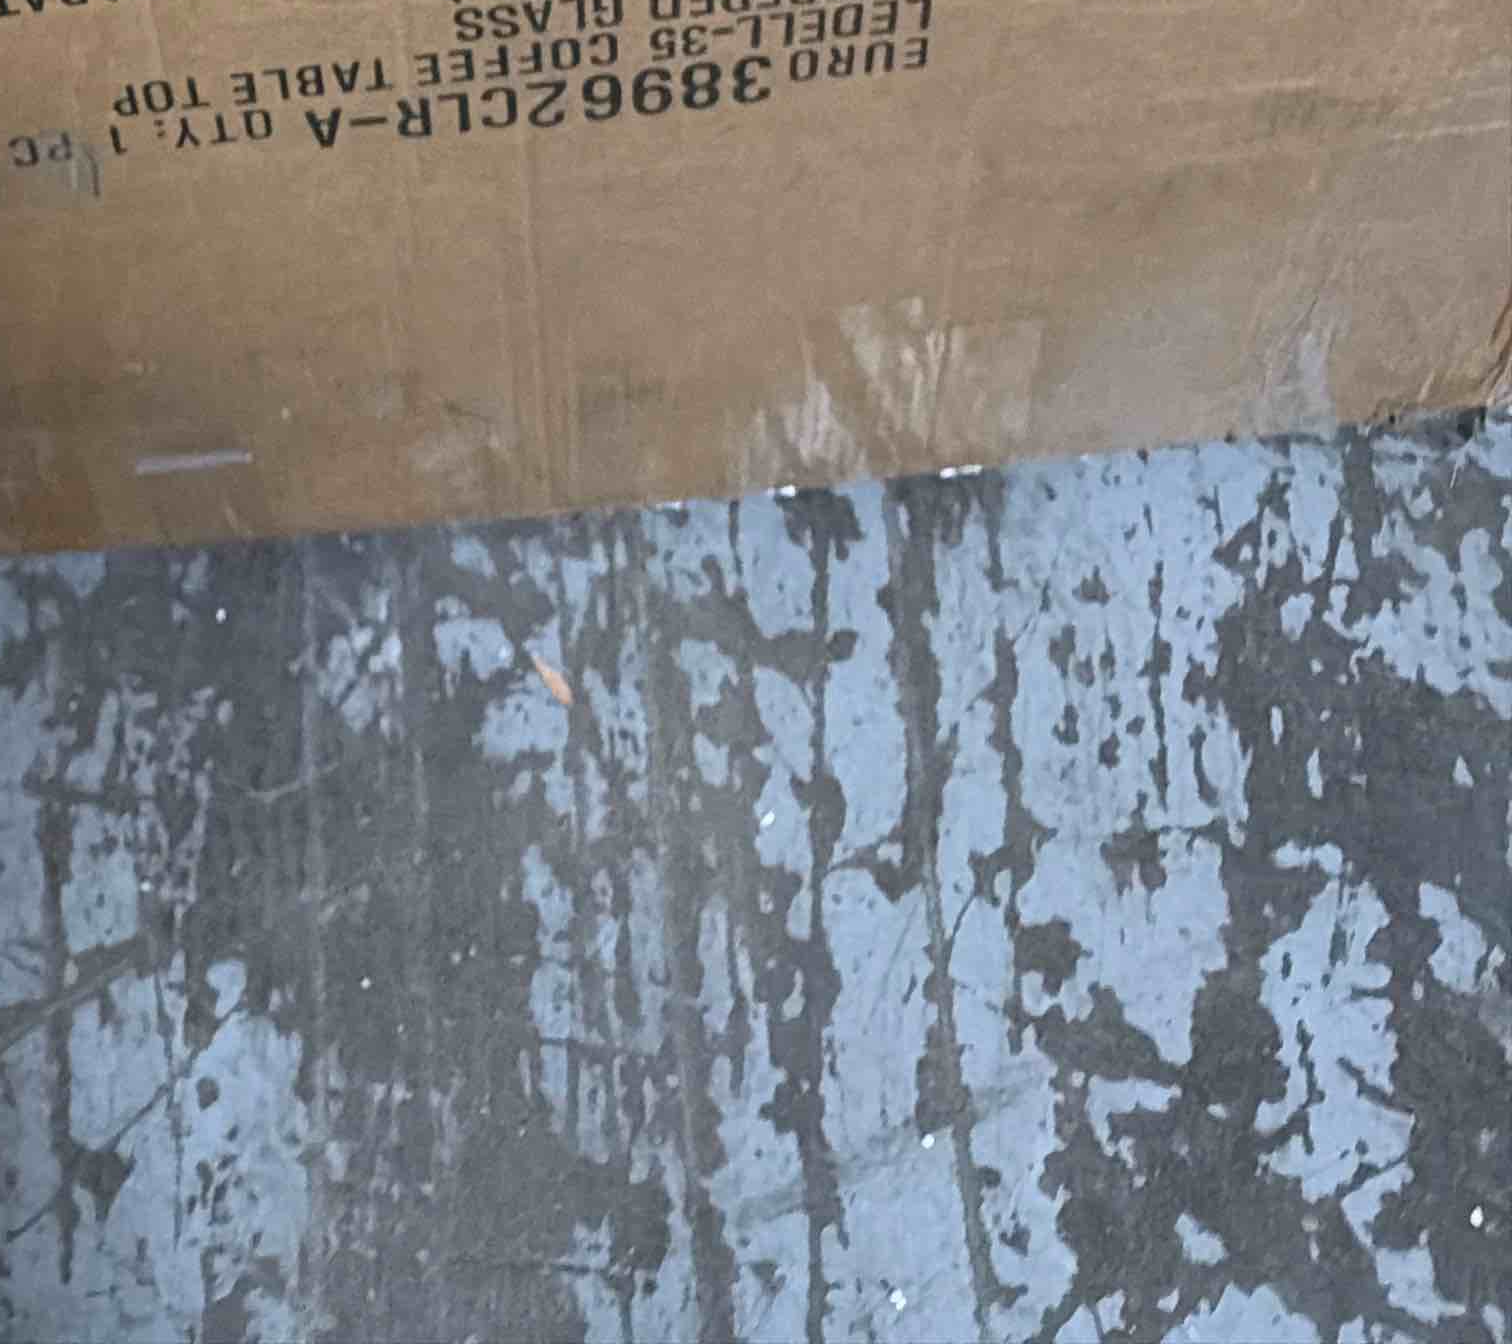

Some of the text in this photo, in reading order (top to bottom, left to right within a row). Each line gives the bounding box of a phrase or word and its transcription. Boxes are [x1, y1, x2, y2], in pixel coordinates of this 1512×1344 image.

[230, 57, 394, 105] TABLE
[417, 33, 619, 85] COFFEE
[8, 37, 929, 168] EURO 38962CLR-A QTY: 1 PC
[113, 76, 212, 117] TOP
